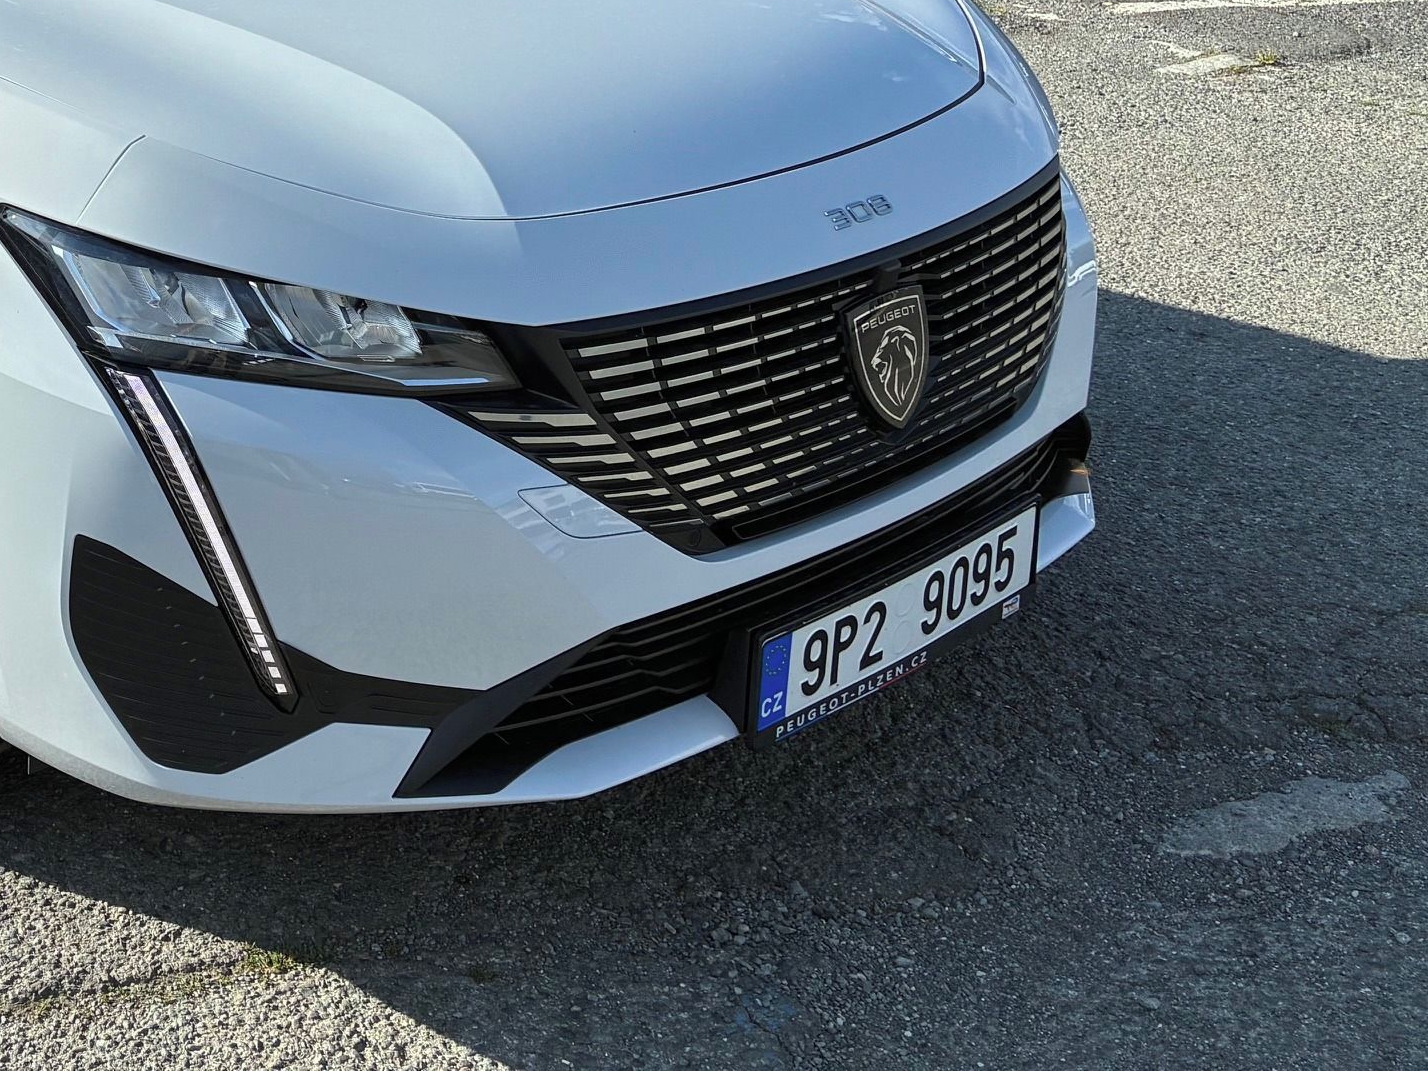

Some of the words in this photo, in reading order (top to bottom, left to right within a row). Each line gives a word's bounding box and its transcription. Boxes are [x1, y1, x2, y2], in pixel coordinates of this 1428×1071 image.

[824, 194, 893, 231] 308
[861, 305, 916, 333] PEUGEOT
[801, 601, 888, 696] 9P2
[921, 525, 1018, 635] 9095
[761, 691, 784, 718] CZ
[776, 651, 927, 738] PEUGEOT-PLZEN.CZ
